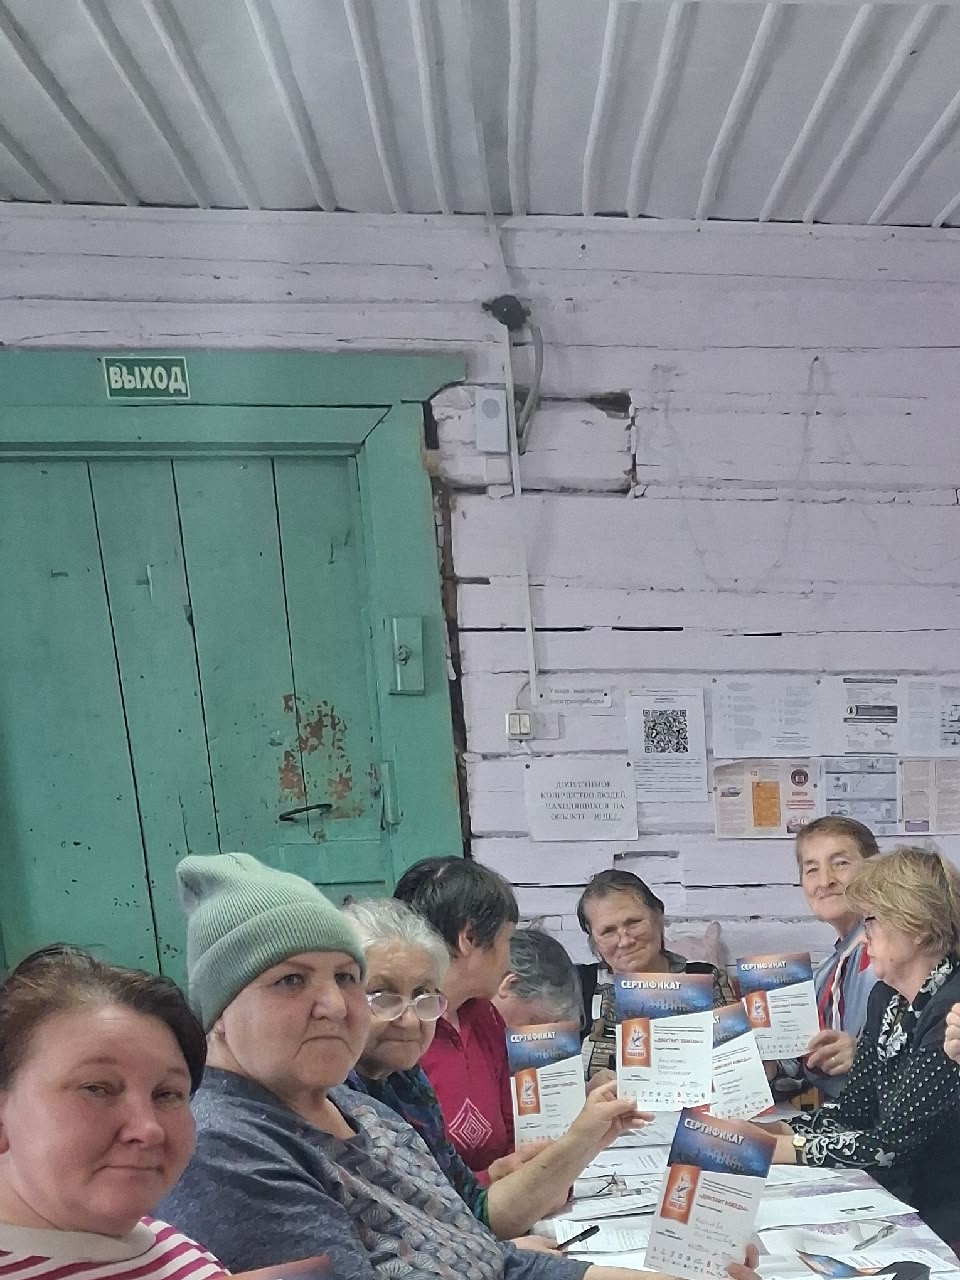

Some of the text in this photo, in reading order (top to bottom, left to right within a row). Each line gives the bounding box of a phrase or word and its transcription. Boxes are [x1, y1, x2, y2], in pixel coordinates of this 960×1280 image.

[109, 366, 186, 393] ВЫХОД
[741, 961, 787, 971] СЕРТИФИКАТ
[620, 980, 681, 990] СЕРТИФИКАТ
[510, 1031, 556, 1043] СЕРТИФИКАТ
[684, 1118, 745, 1145] СЕРТИФИКАТ
